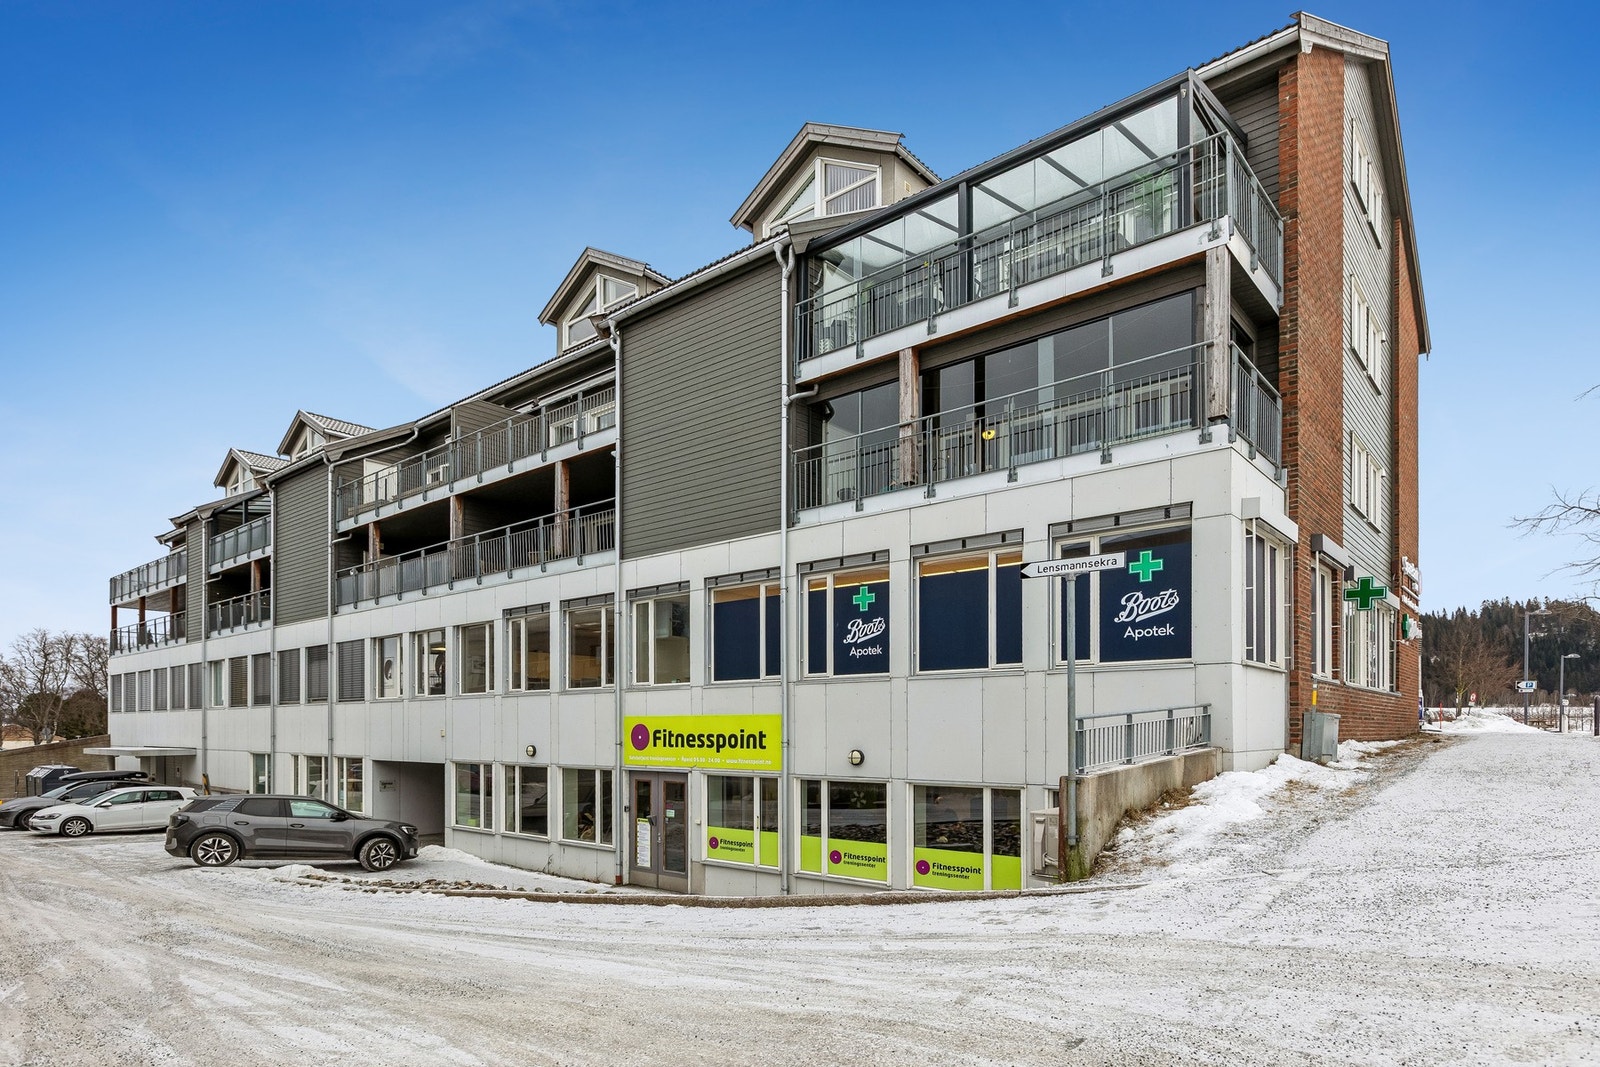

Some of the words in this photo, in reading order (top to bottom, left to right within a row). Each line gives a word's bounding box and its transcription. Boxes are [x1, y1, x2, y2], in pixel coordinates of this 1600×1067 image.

[1037, 558, 1117, 574] Lensmannsekra
[1114, 588, 1179, 623] Boots
[843, 617, 886, 644] Boots
[1123, 623, 1175, 641] Apotek
[849, 645, 883, 658] Apotek
[652, 729, 767, 753] Fitnesspoint
[720, 839, 754, 848] Fitnesspoint
[843, 852, 886, 863] Fitnesspoint
[843, 860, 876, 868] treningssenter
[932, 862, 982, 875] Fitnesspoint
[932, 871, 970, 880] treningssenter
